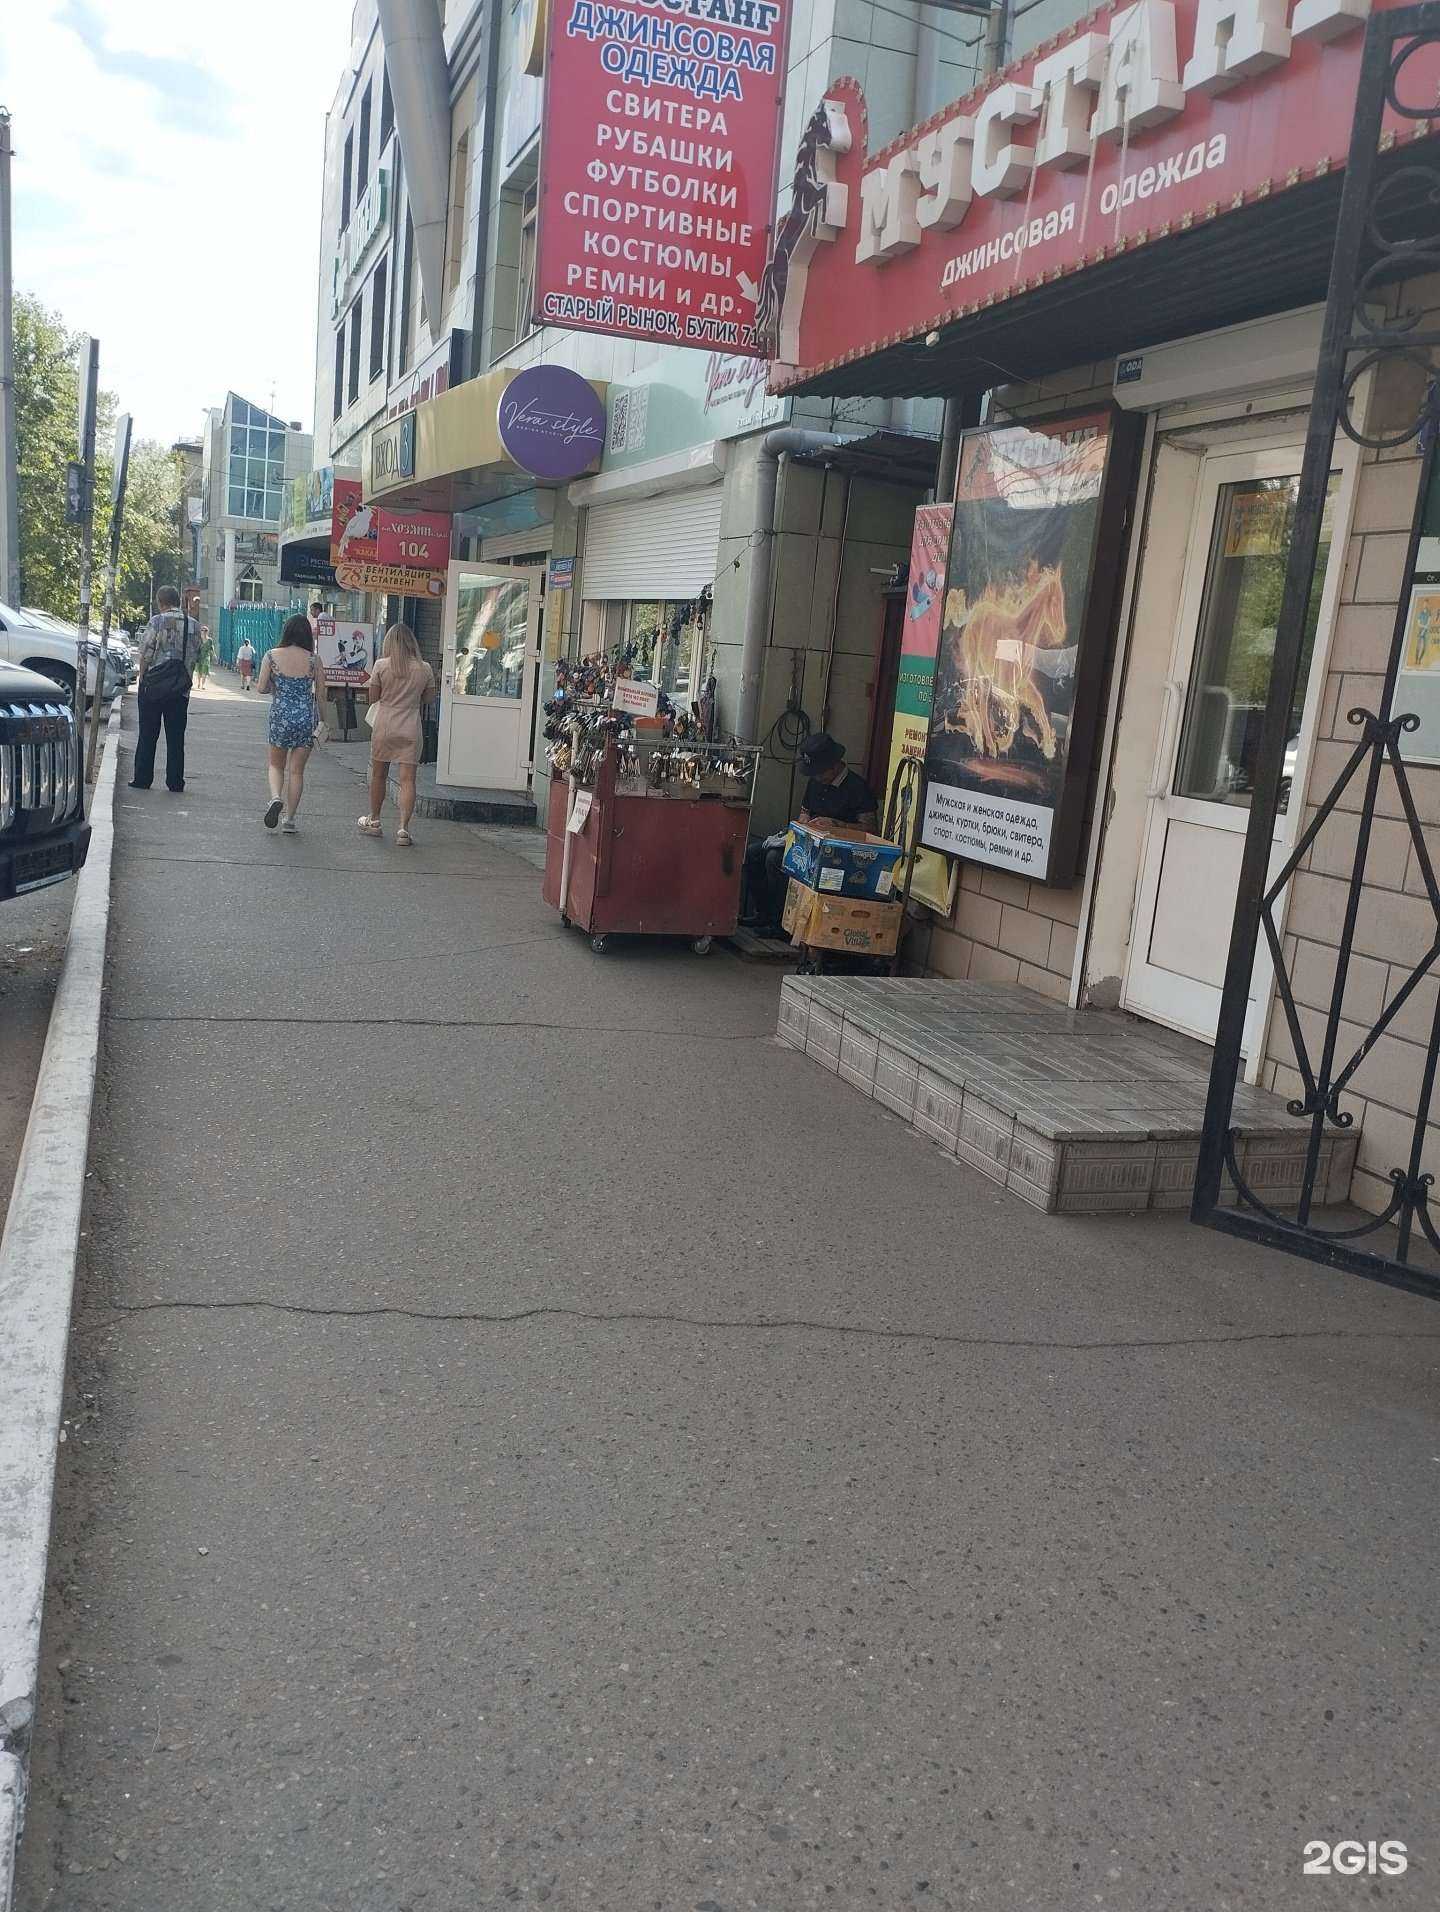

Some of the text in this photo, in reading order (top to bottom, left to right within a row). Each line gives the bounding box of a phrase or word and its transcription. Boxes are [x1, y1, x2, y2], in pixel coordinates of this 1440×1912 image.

[569, 2, 775, 73] ДЖИНСОВАЯ
[601, 43, 743, 100] ОДЕЖДА
[606, 90, 727, 135] СВИТЕРА
[855, 0, 1373, 266] МУСТАН
[597, 124, 733, 172] РУБАШКИ
[586, 159, 737, 208] ФУТБОЛКИ
[564, 192, 753, 246] СПОРТИВНЫЕ
[940, 133, 1227, 289] джинсовая одежда
[584, 231, 732, 277] КОСТЮМЫ
[567, 264, 743, 316] РЕМНИ и др.
[545, 293, 613, 326] СТАРЫЙ
[617, 305, 681, 339] РЫНОК,
[687, 316, 738, 345] БУТИК
[505, 398, 604, 444] Vera style
[375, 423, 409, 480] ВХОД 3
[365, 565, 431, 580] ВЕНТИЛЯЦИЯ
[399, 541, 430, 558] 104
[928, 810, 1044, 850] джинсы, куртки, брюки, свитера,
[936, 793, 1038, 830] Мужская и женская одежда,
[933, 826, 1033, 864] спорт. костюмы, ремни и др.
